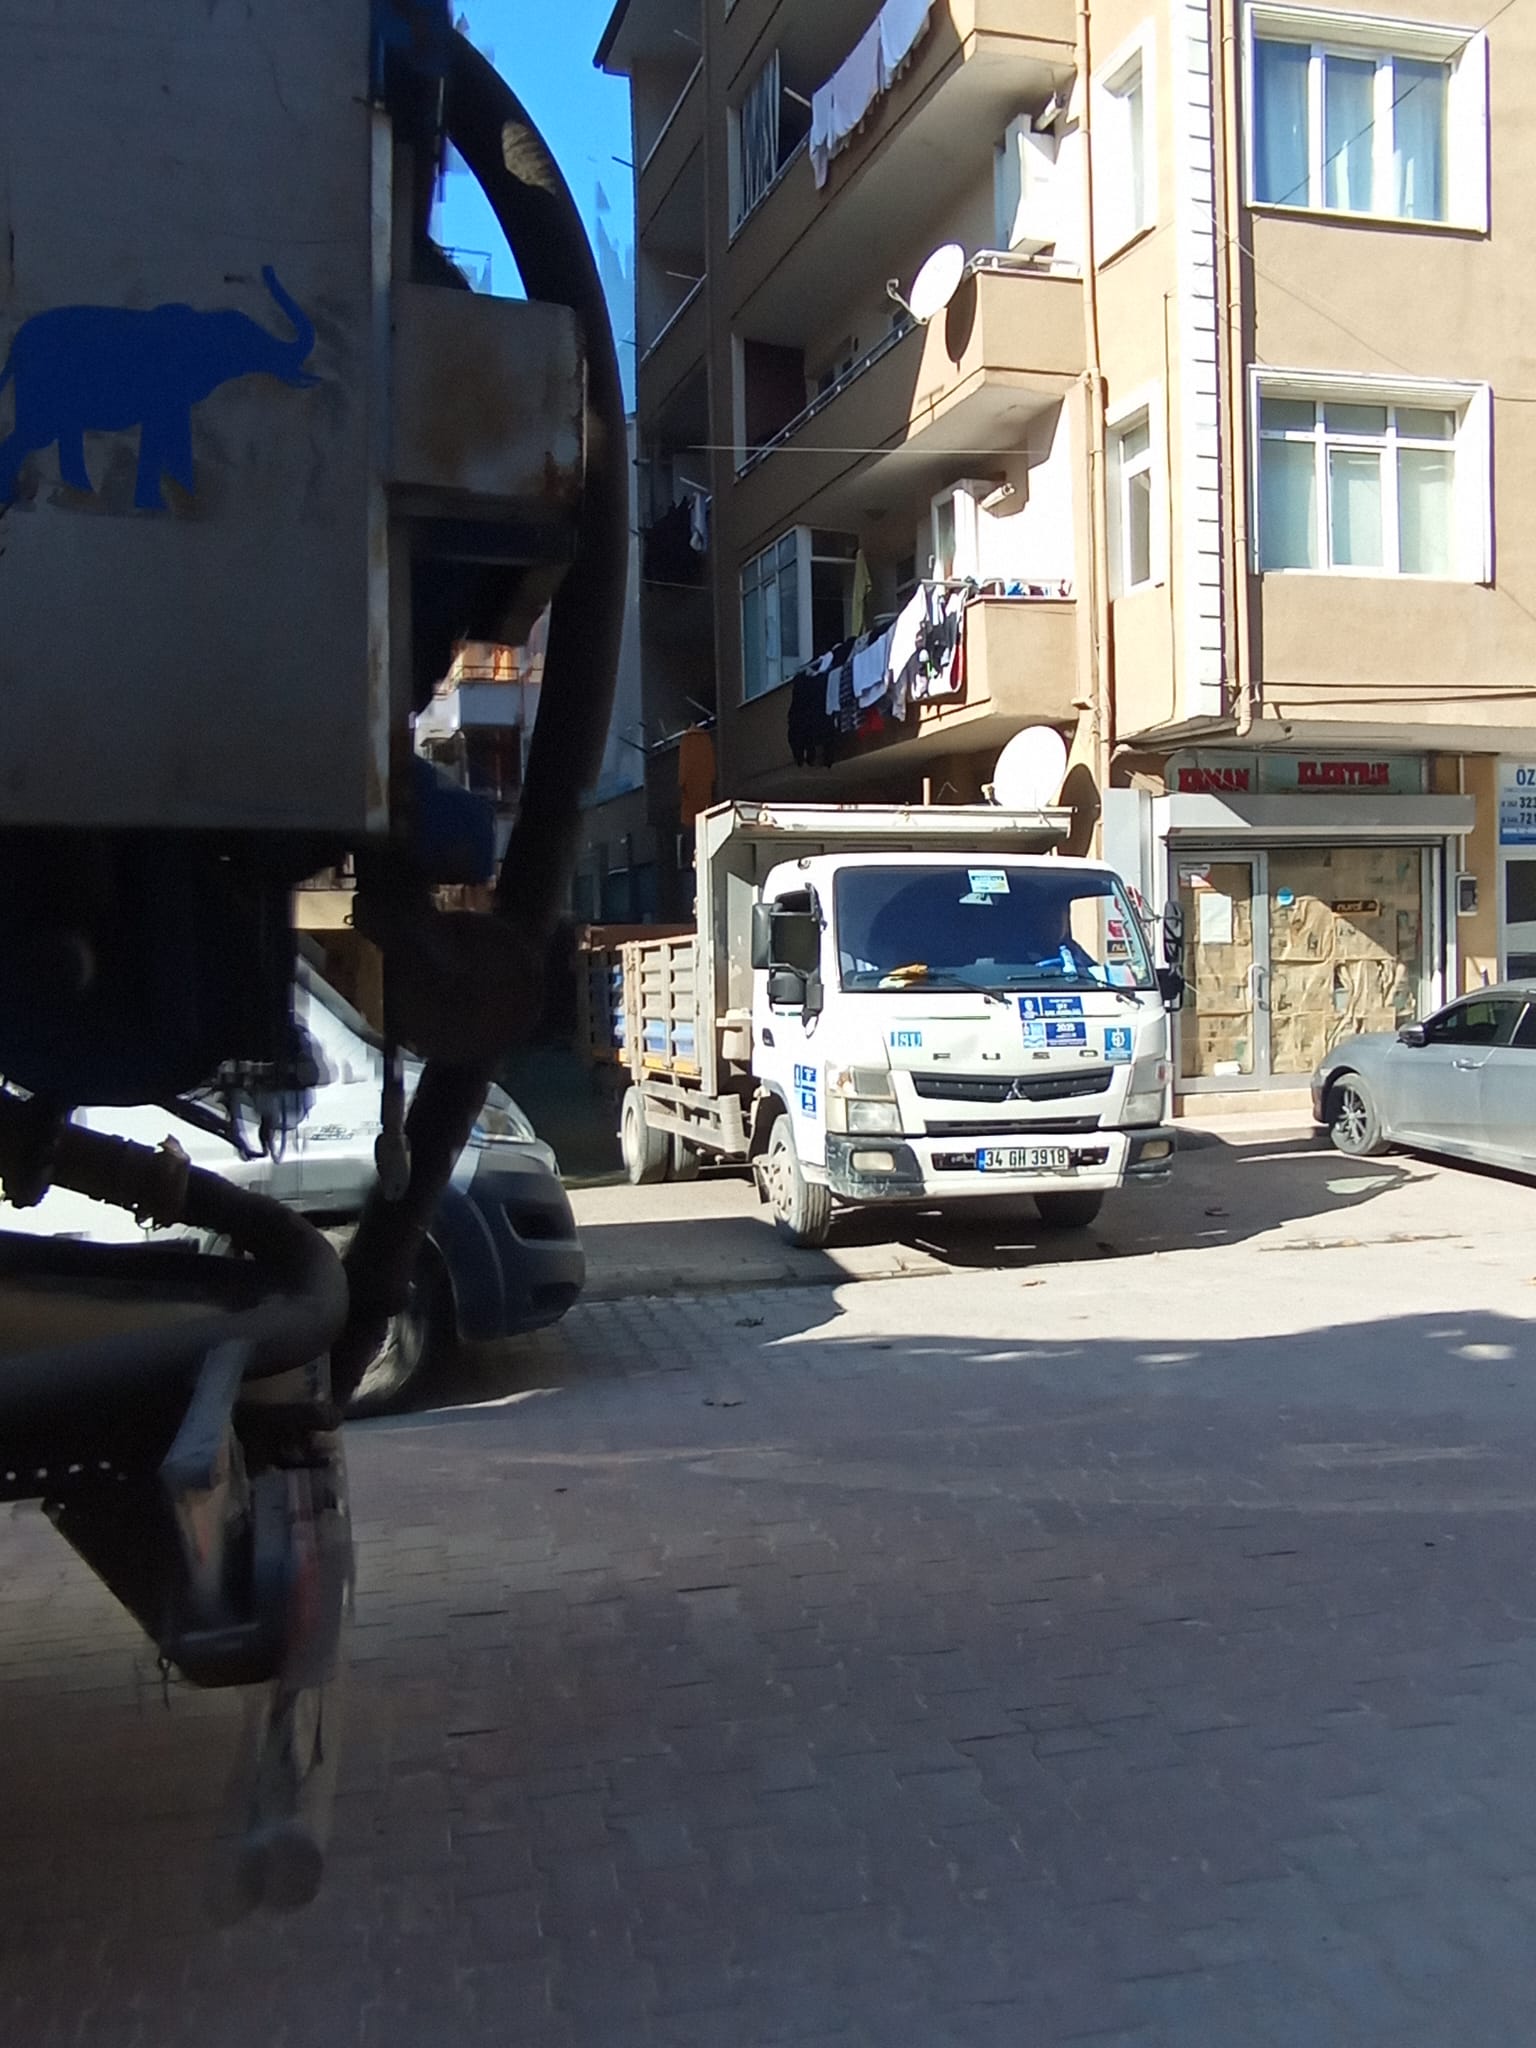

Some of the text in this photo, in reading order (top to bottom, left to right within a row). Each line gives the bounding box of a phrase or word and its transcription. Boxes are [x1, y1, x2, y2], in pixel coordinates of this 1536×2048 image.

[932, 1049, 1099, 1061] FUSO
[986, 1147, 1066, 1167] 34 GH 3918
